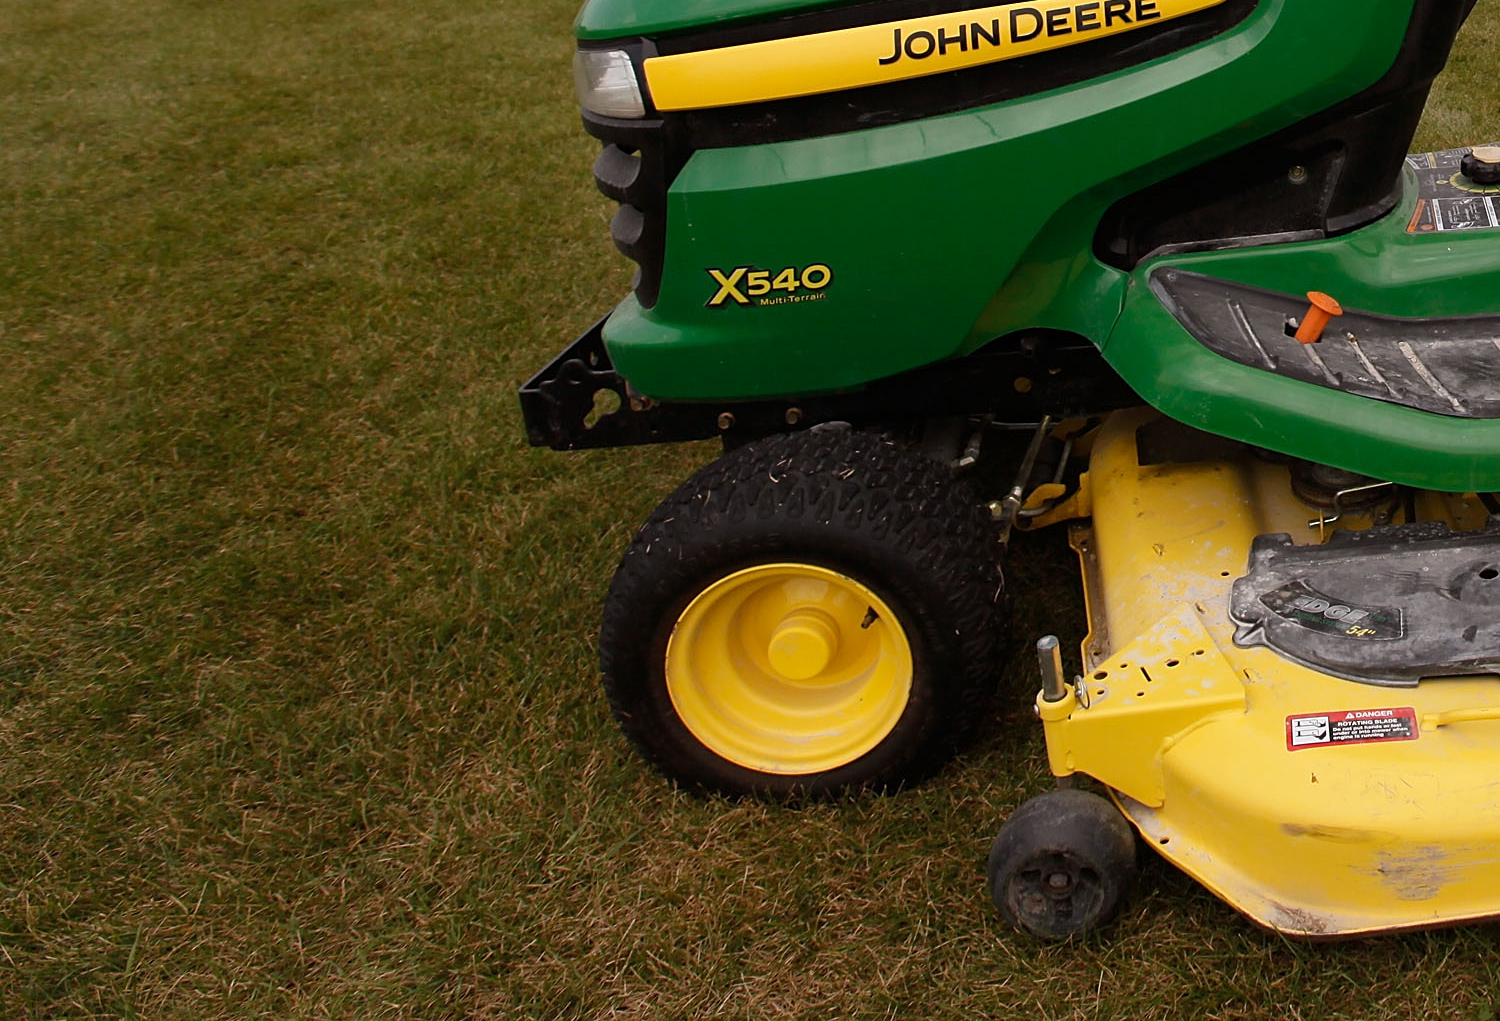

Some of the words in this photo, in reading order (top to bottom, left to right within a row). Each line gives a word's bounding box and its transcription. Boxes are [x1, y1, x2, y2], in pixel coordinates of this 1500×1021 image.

[879, 19, 999, 66] JOHN
[706, 264, 832, 307] X540
[760, 292, 826, 306] Multi-Terrain
[1346, 625, 1377, 637] 54"
